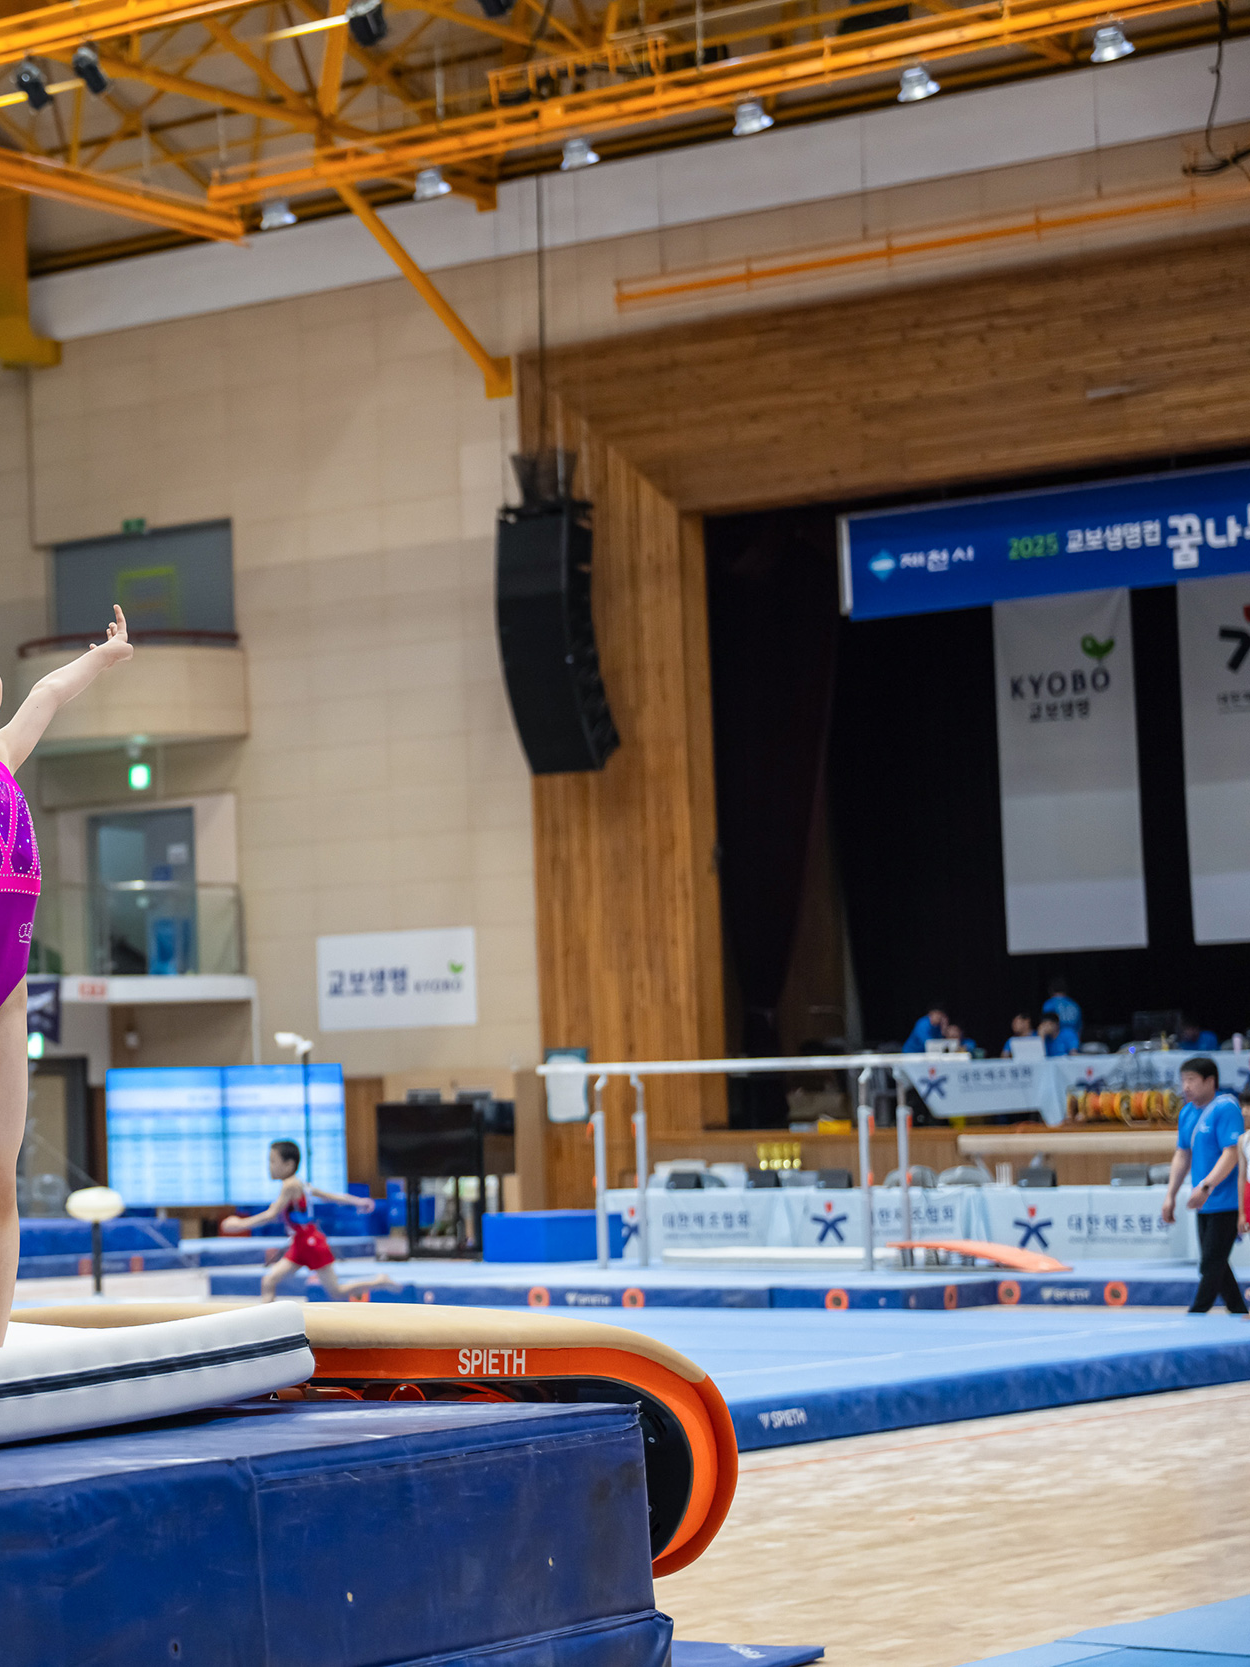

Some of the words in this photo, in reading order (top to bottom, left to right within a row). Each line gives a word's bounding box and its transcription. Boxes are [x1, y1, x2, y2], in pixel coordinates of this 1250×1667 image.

[1007, 532, 1059, 561] 2025
[1167, 502, 1250, 570] 꿈나
[900, 545, 974, 572] 제천시
[1010, 666, 1111, 700] KYOBO
[457, 1349, 526, 1375] SPIETH
